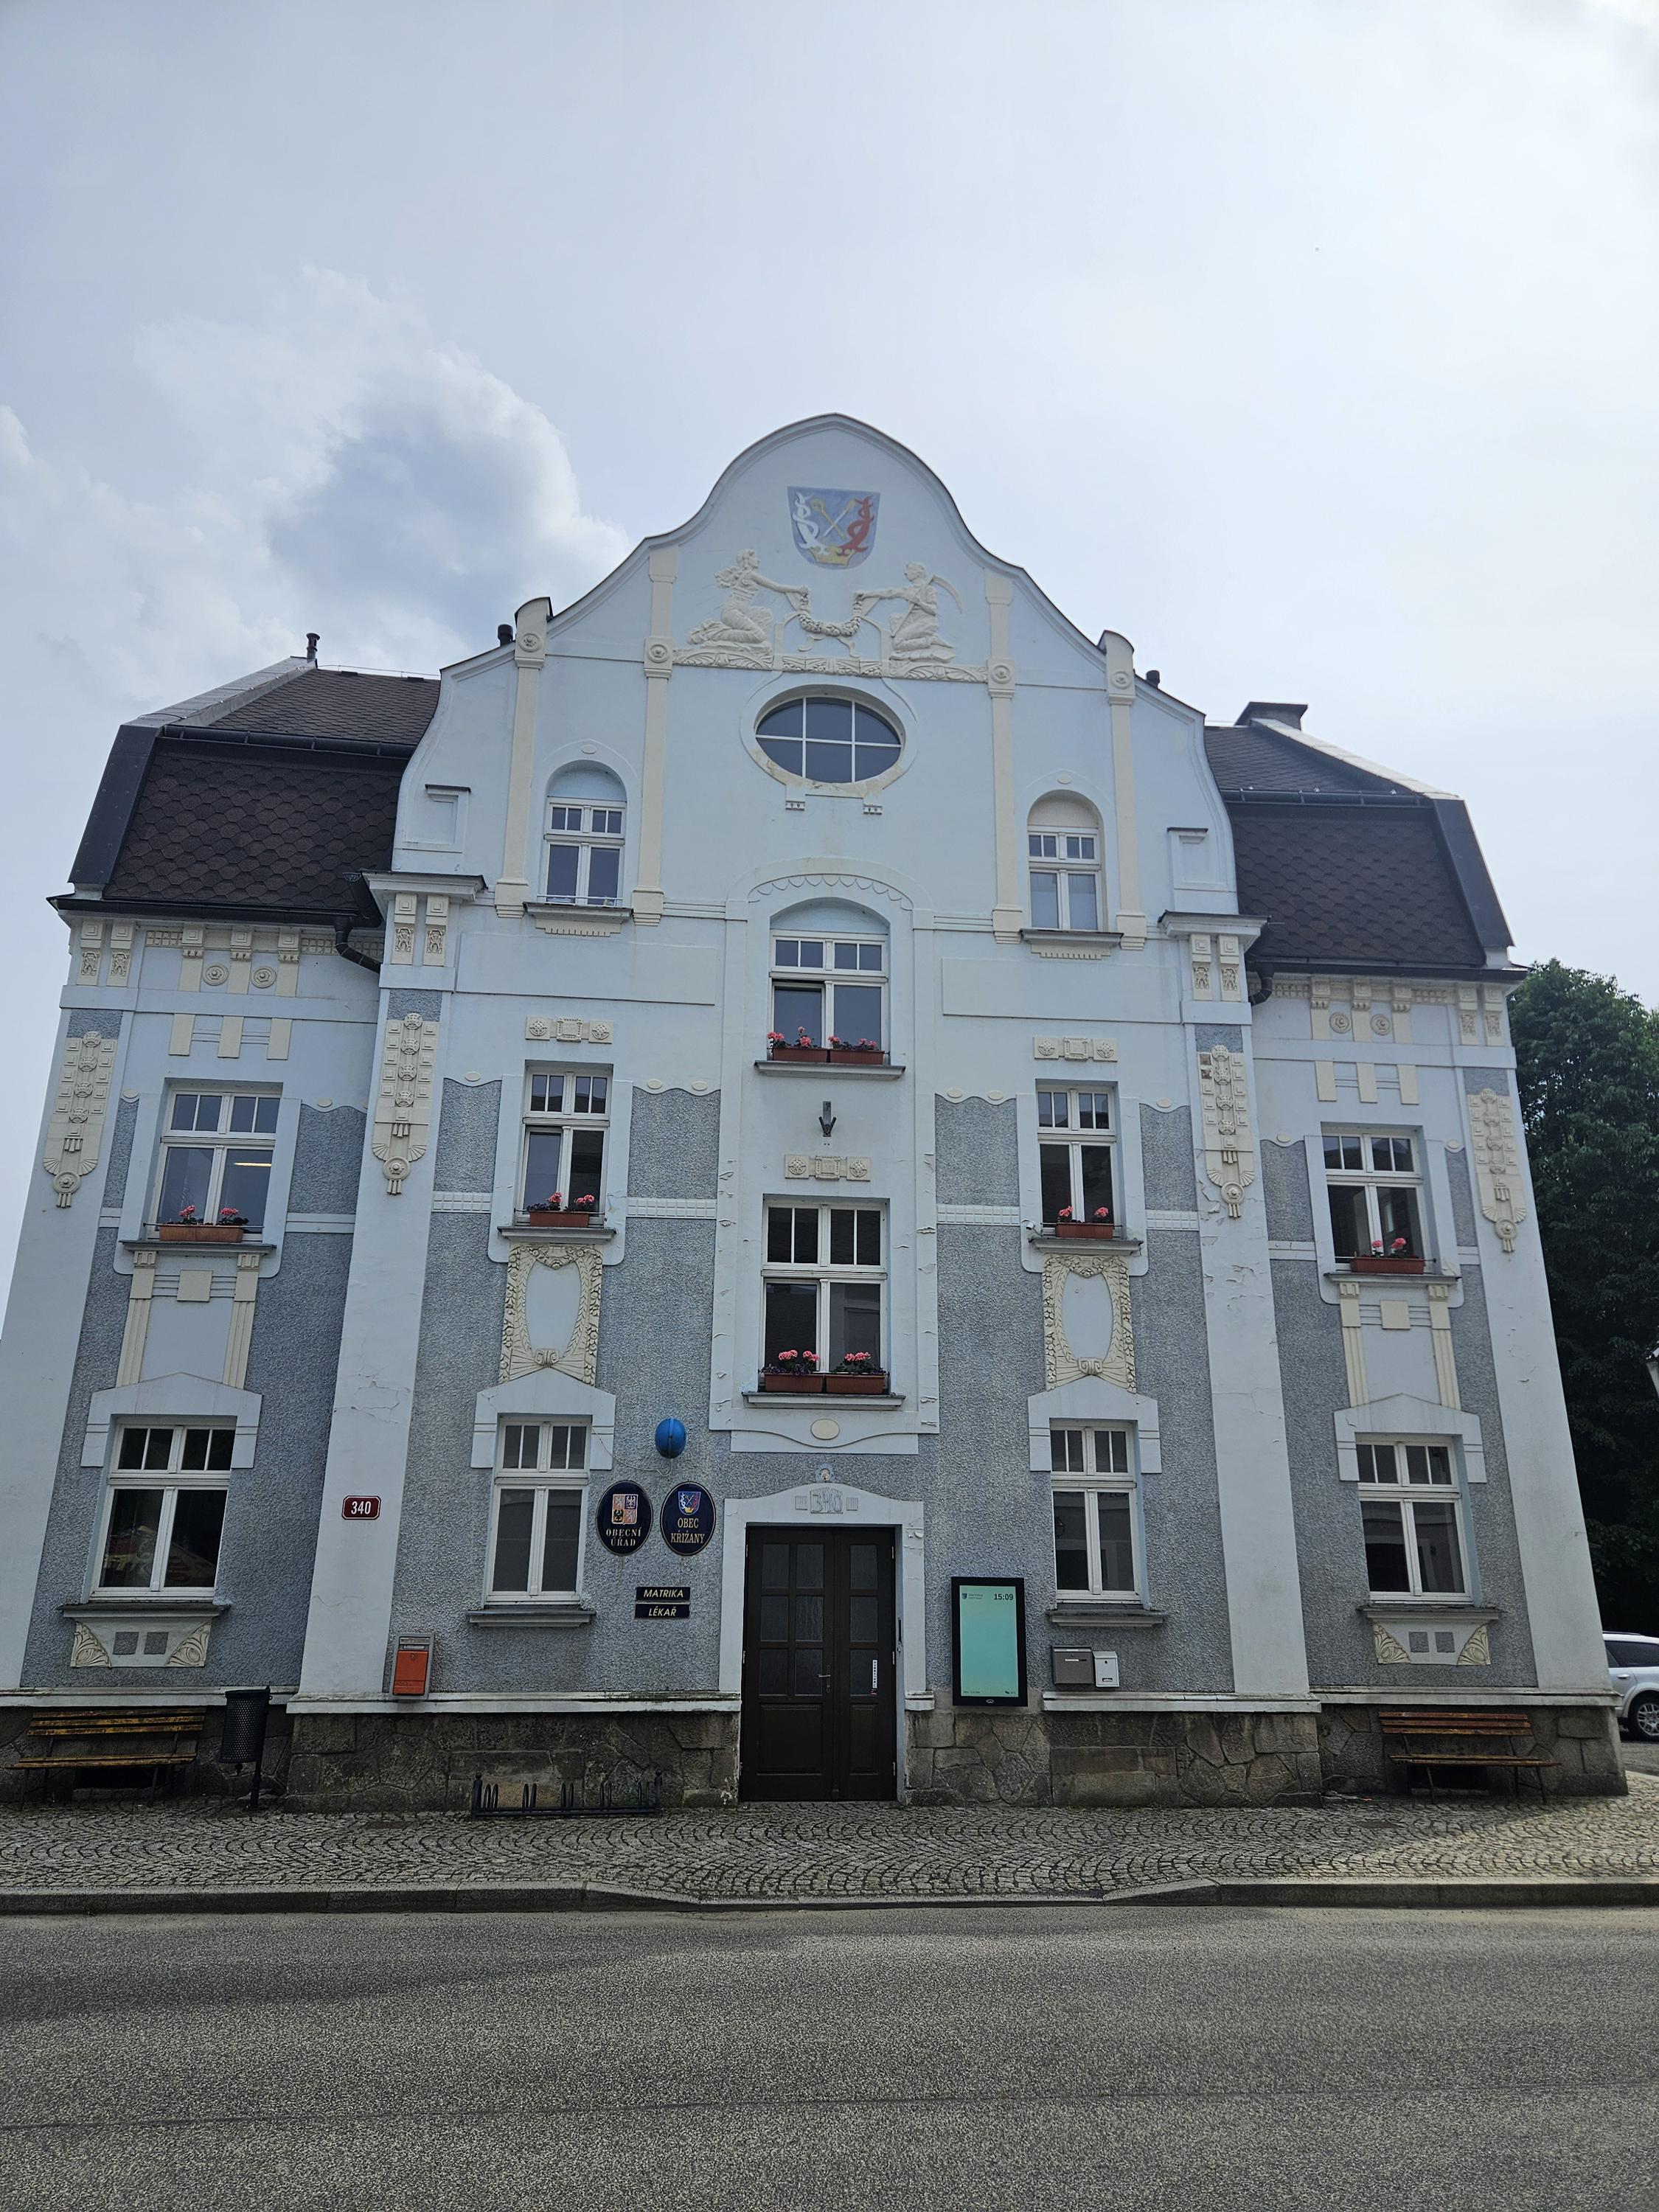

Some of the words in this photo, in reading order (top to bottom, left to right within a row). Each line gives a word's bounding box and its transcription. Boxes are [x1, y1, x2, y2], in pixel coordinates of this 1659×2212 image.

[351, 1500, 372, 1514] 340
[677, 1517, 699, 1528] OBEC
[605, 1526, 642, 1537] OBECNÍ
[670, 1530, 705, 1543] KŘIŽANY
[611, 1536, 636, 1546] ÚŘAD
[643, 1589, 684, 1598] MATRIKA
[648, 1605, 677, 1616] LÉKAŘ
